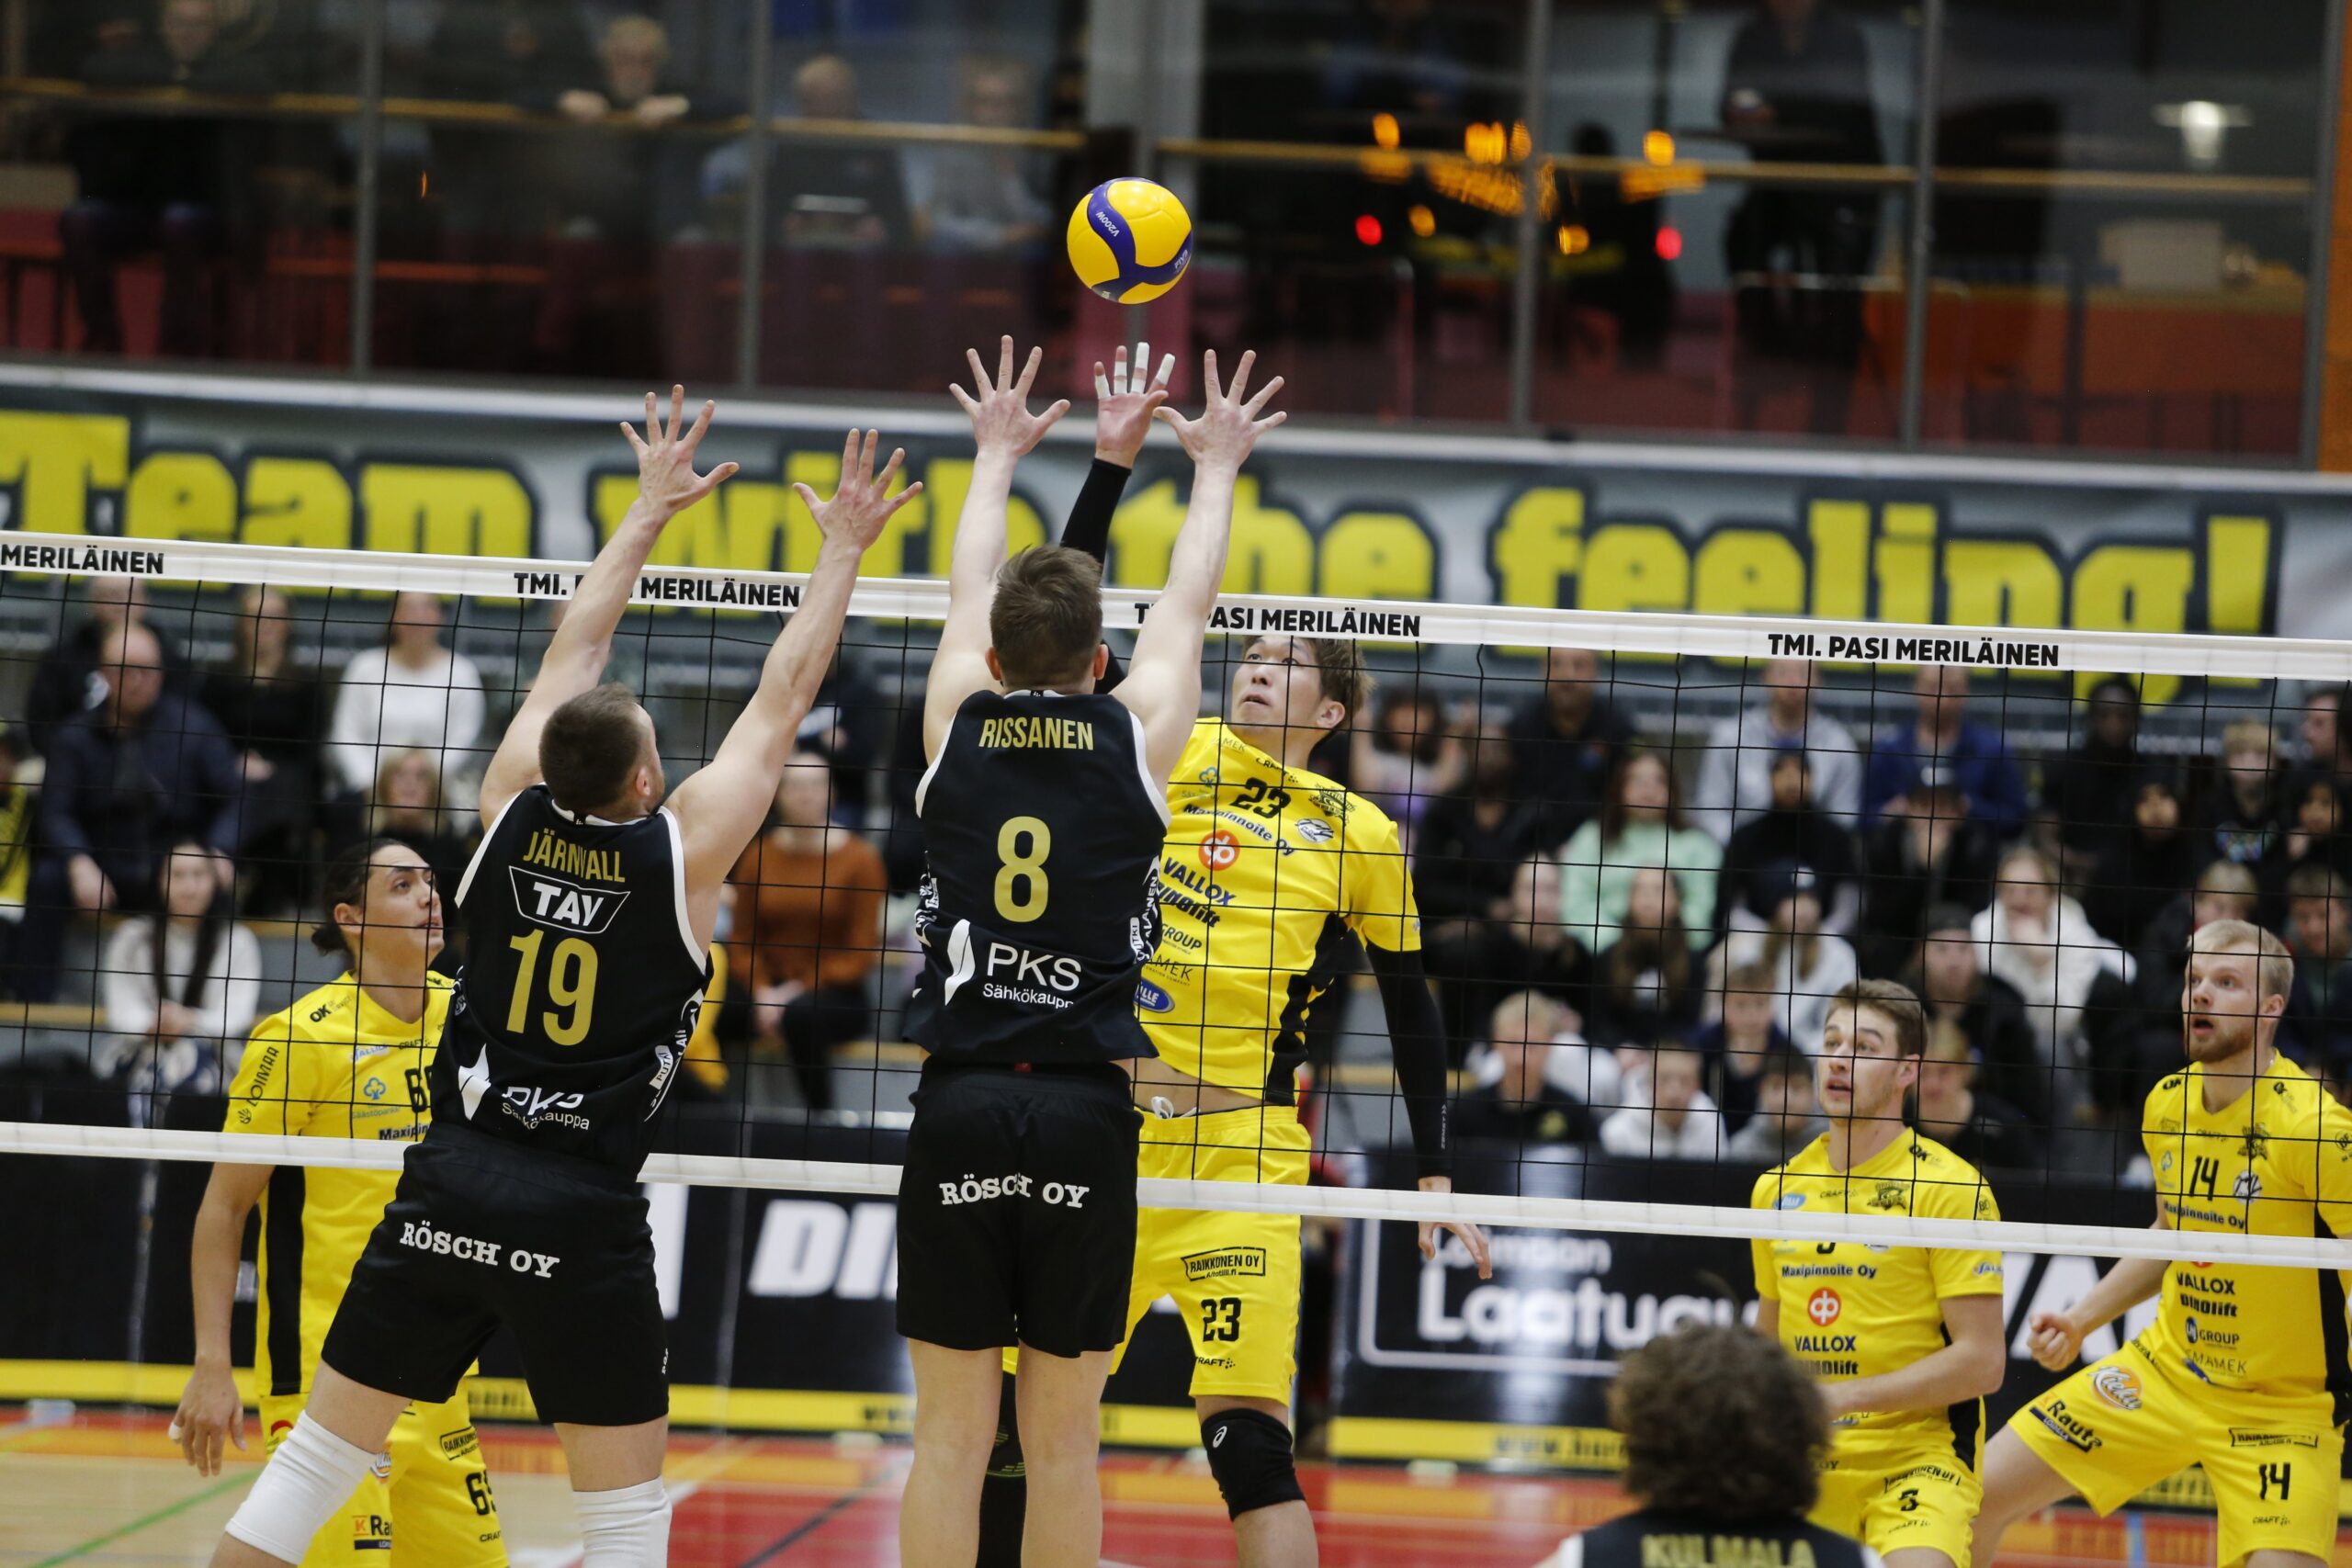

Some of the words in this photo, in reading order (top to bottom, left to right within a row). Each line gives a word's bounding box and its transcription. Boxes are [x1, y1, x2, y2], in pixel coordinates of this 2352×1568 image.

[1095, 211, 1120, 237] V200W
[0, 544, 164, 574] MERILÄINEN
[0, 411, 533, 599] Team
[1494, 487, 2272, 715] feeling!
[514, 572, 568, 595] TMI.
[641, 577, 800, 607] MERILÄINEN
[1207, 606, 1254, 630] ASI
[1261, 607, 1420, 637] MERILÄINEN
[1768, 634, 1822, 657] TMI.
[1828, 636, 1888, 660] PASI
[1895, 637, 2059, 667] MERILÄINEN
[978, 717, 1094, 750] RISSANEN
[1229, 776, 1292, 819] 23
[994, 816, 1051, 922] 8
[1163, 857, 1236, 907] VALLOX
[987, 942, 1082, 991] PKS
[506, 929, 598, 1046] 19
[982, 983, 1074, 1009] Sähkökaup
[310, 1004, 332, 1022] OK
[246, 1046, 280, 1107] LOIMAA
[378, 1123, 430, 1140] Maxipin
[502, 1102, 590, 1131] Säköauppa
[939, 1172, 1033, 1206] RÖSCH
[1042, 1181, 1091, 1209] OY
[2188, 1156, 2220, 1201] 14
[400, 1220, 502, 1266] RÖSCH
[511, 1249, 560, 1279] OY
[1245, 1255, 1260, 1268] OY
[1781, 1264, 1854, 1278] Maxipinnoite
[1858, 1264, 1877, 1279] Oy
[2177, 1271, 2235, 1295] VALLOX
[1201, 1297, 1242, 1342] 23
[1794, 1336, 1857, 1351] VALLOX
[2199, 1329, 2240, 1345] GROUP
[2259, 1462, 2291, 1501] 14
[480, 1530, 502, 1542] CRAF
